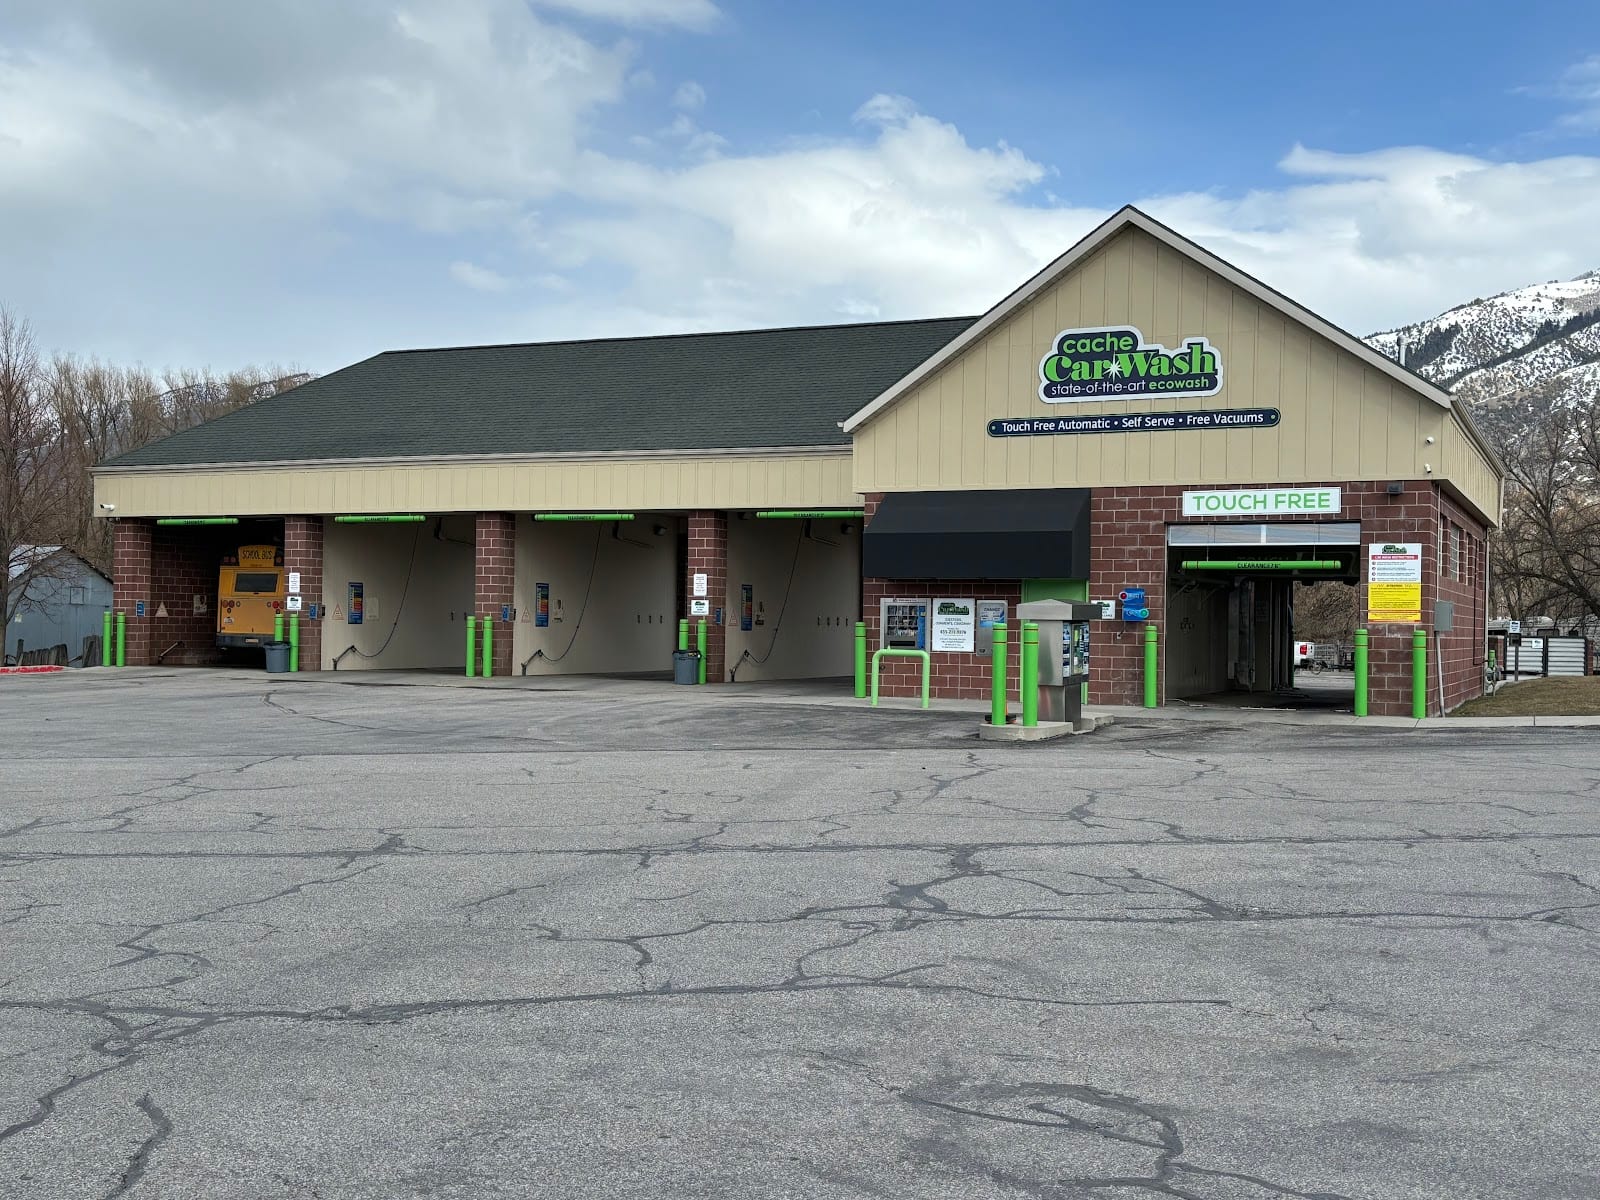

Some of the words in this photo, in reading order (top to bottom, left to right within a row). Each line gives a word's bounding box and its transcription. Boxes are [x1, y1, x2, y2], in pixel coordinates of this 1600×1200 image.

[1062, 333, 1133, 354] cache
[1044, 355, 1107, 382] Car
[1116, 344, 1216, 377] Wash
[1051, 380, 1146, 395] state-of-the-art
[1149, 376, 1209, 390] ecowash
[1002, 421, 1031, 432] Touch
[1034, 420, 1056, 431] Free
[1058, 418, 1111, 430] Automatic
[1122, 417, 1142, 428] Self
[1144, 416, 1174, 428] Serve
[1187, 414, 1211, 425] Free
[1213, 412, 1264, 424] Vacuums
[1193, 494, 1267, 511] TOUCH
[1274, 492, 1331, 509] FREE
[242, 550, 260, 560] SCHOOL
[262, 550, 273, 560] BUS
